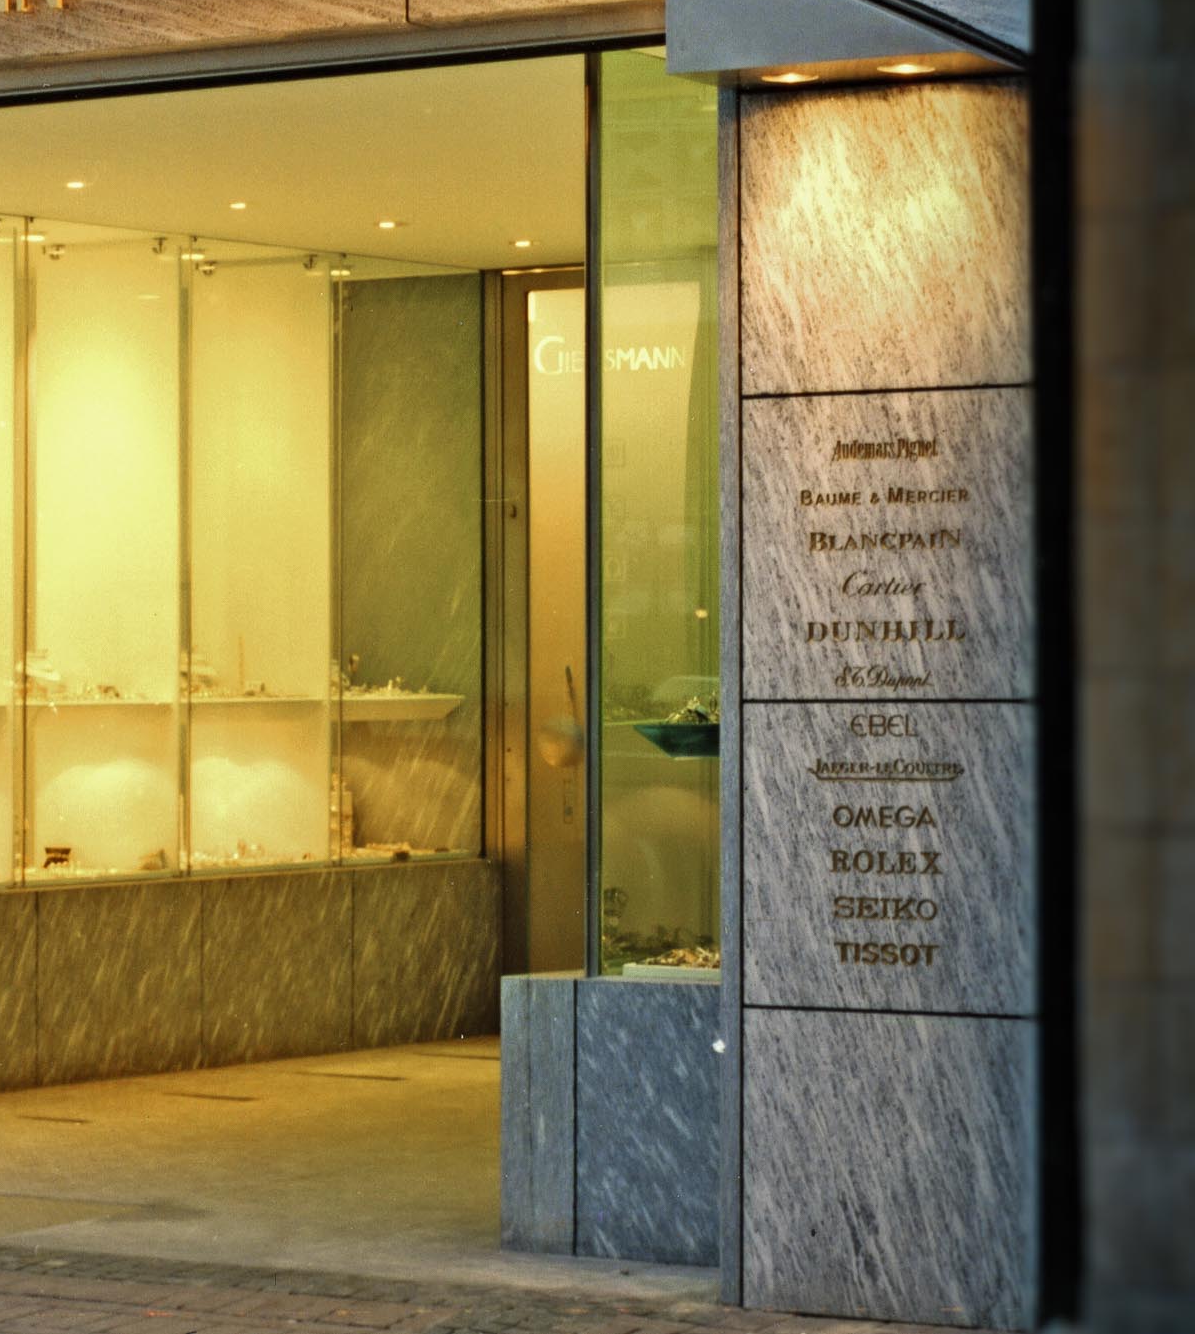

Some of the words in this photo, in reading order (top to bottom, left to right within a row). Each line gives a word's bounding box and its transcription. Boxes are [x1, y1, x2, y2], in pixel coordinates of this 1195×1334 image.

[533, 335, 686, 375] GIESMANN
[831, 440, 895, 463] Audemars
[800, 490, 861, 507] BAUME
[870, 493, 880, 505] &
[887, 487, 970, 506] MERCIER
[809, 529, 962, 553] BLANCPAIN
[842, 571, 926, 598] Cartier
[805, 620, 966, 643] DUNHILL
[866, 664, 934, 692] Dupont
[850, 714, 919, 737] EBEL
[832, 805, 937, 828] OMEGA
[830, 850, 943, 875] ROLEX
[833, 897, 938, 922] SEIKO
[835, 941, 940, 966] TISSOT
